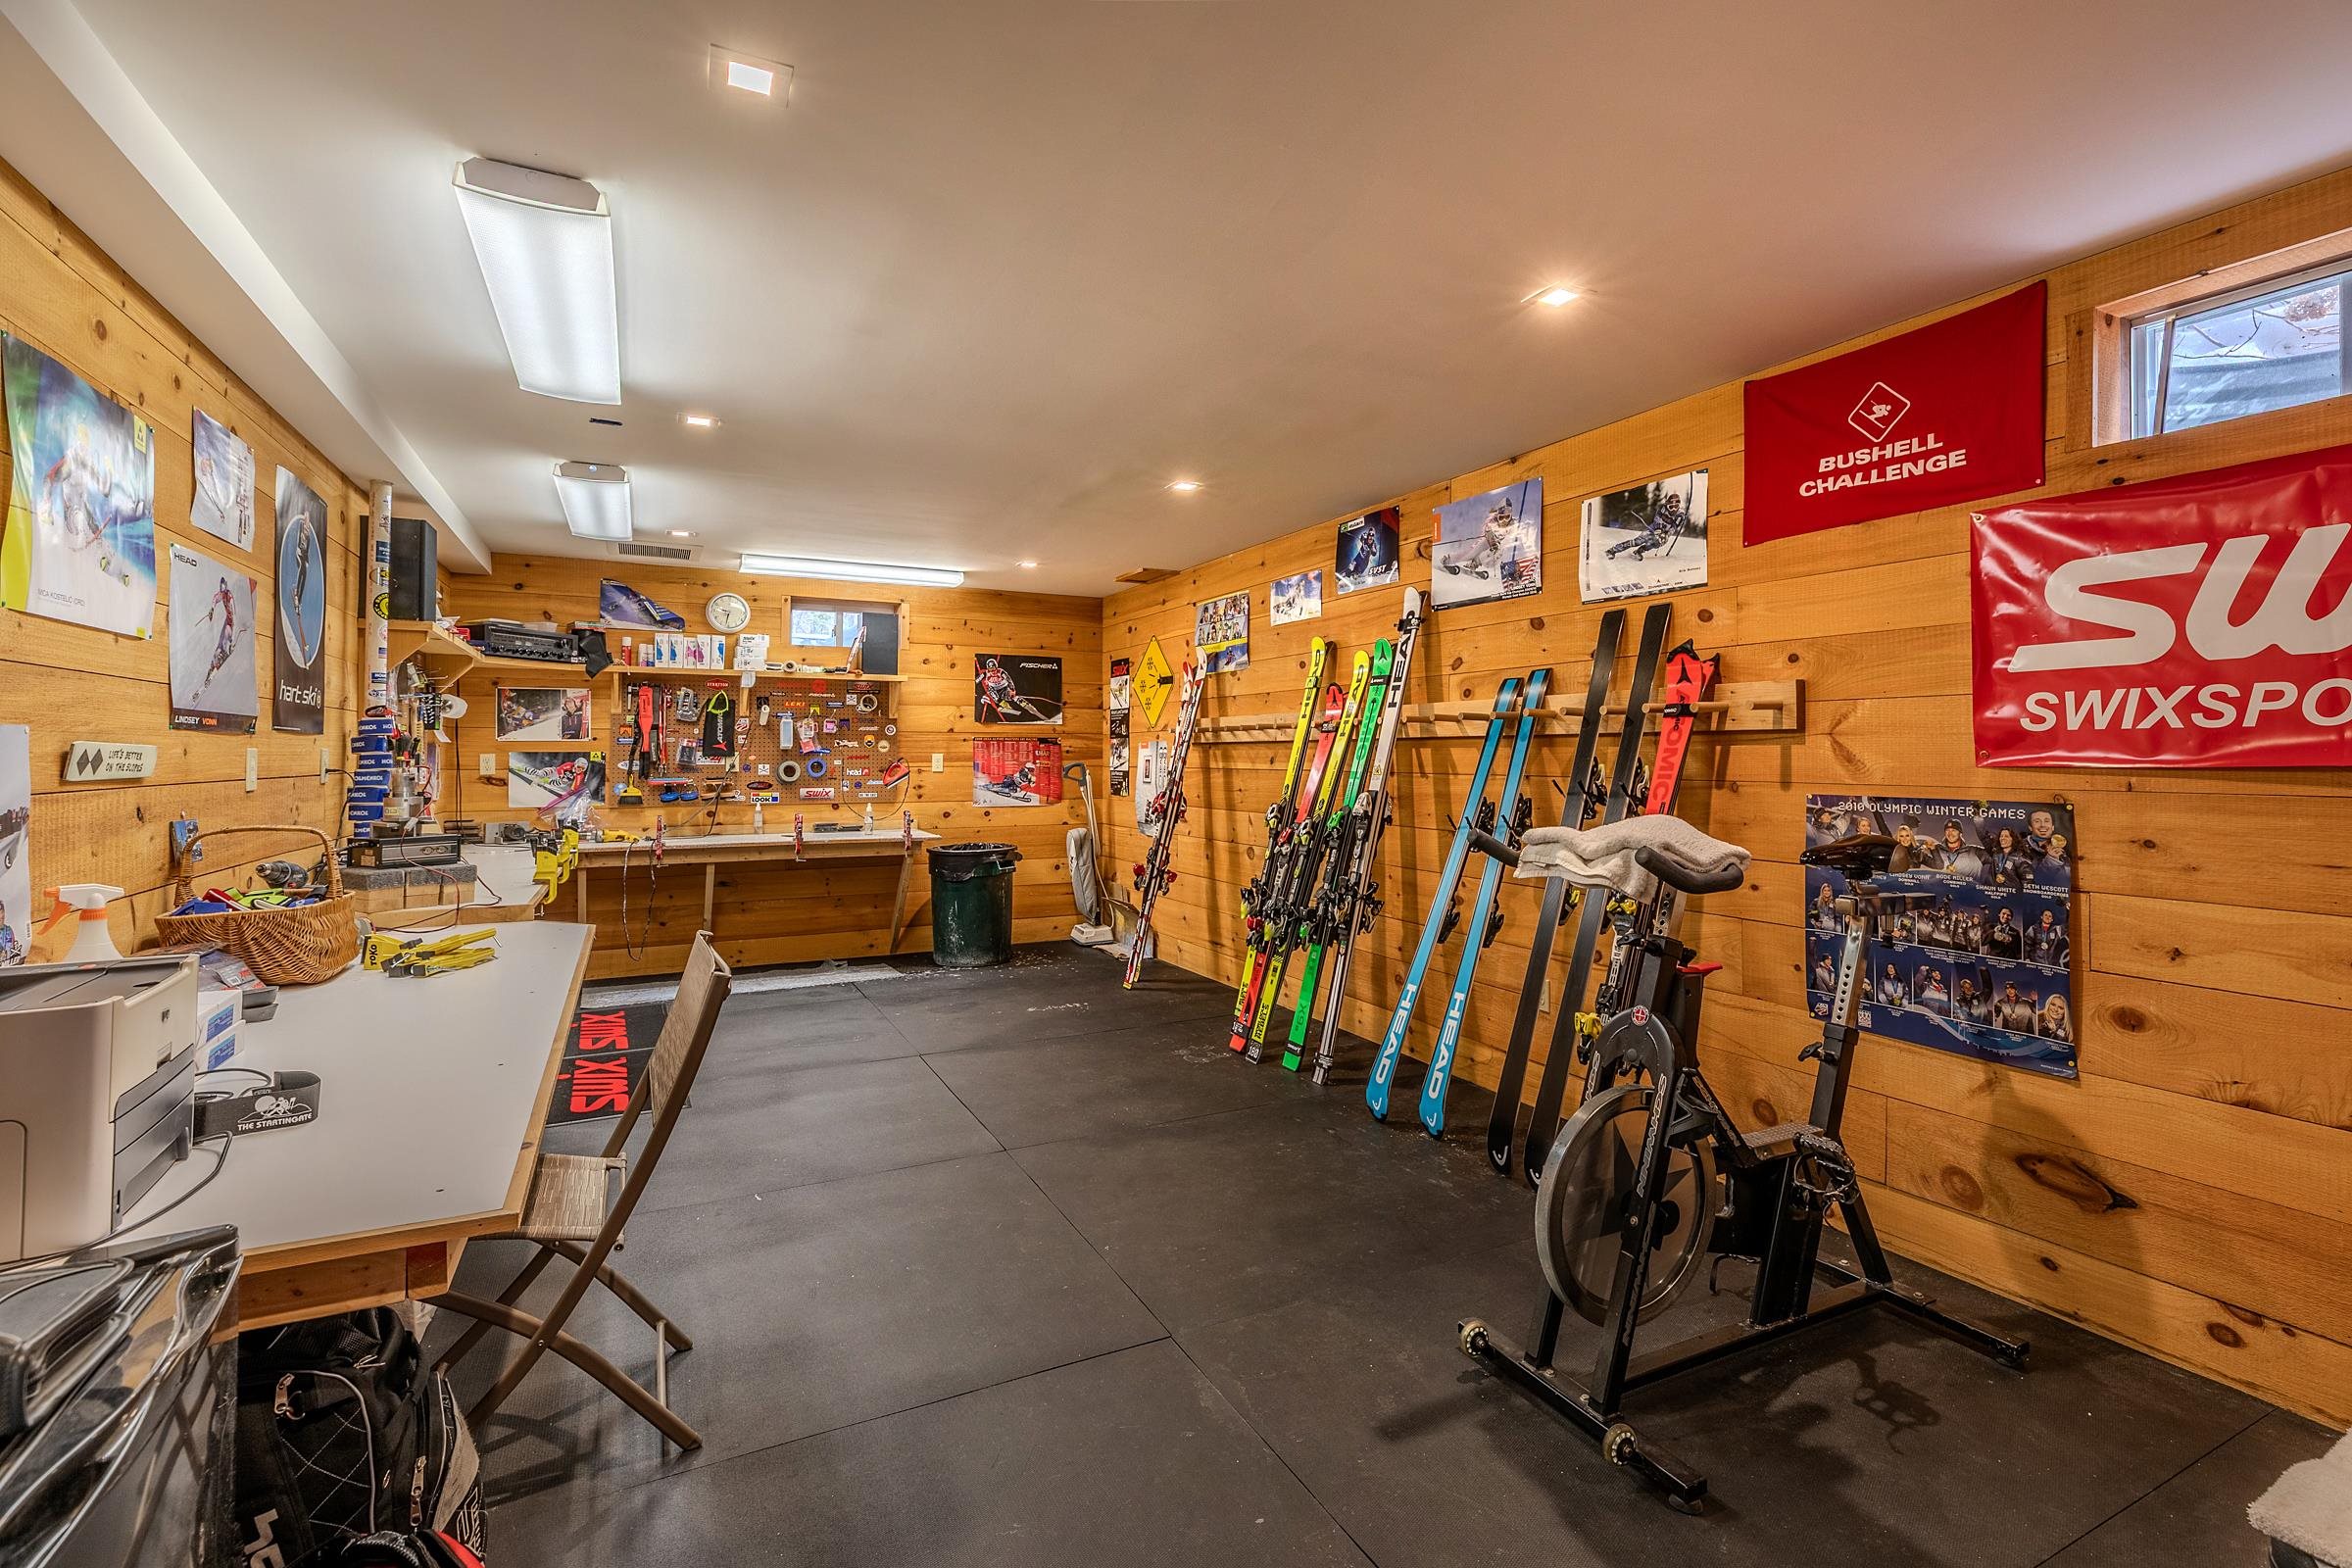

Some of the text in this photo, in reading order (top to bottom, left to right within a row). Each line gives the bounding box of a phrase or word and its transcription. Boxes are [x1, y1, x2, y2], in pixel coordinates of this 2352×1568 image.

[1818, 433, 1943, 472] BUSHELL
[1799, 449, 1967, 497] CHALLENGE
[173, 552, 197, 566] HEAD
[279, 679, 318, 706] hart ski
[2020, 678, 2352, 732] SWIXSPO
[174, 714, 200, 725] LINDSEY
[202, 717, 218, 726] VONN
[108, 748, 143, 760] LIFE'S BETTER
[105, 762, 144, 772] ON THE SLOPES
[1838, 801, 2027, 819] 2010 OLYMPIC WINTER GAMES
[368, 944, 378, 966] TOKO
[1375, 983, 1417, 1084] HEAD
[1428, 991, 1465, 1099] HEAD
[237, 1112, 313, 1131] THE STARTINGATE
[1637, 1073, 1667, 1198] SCHWINN
